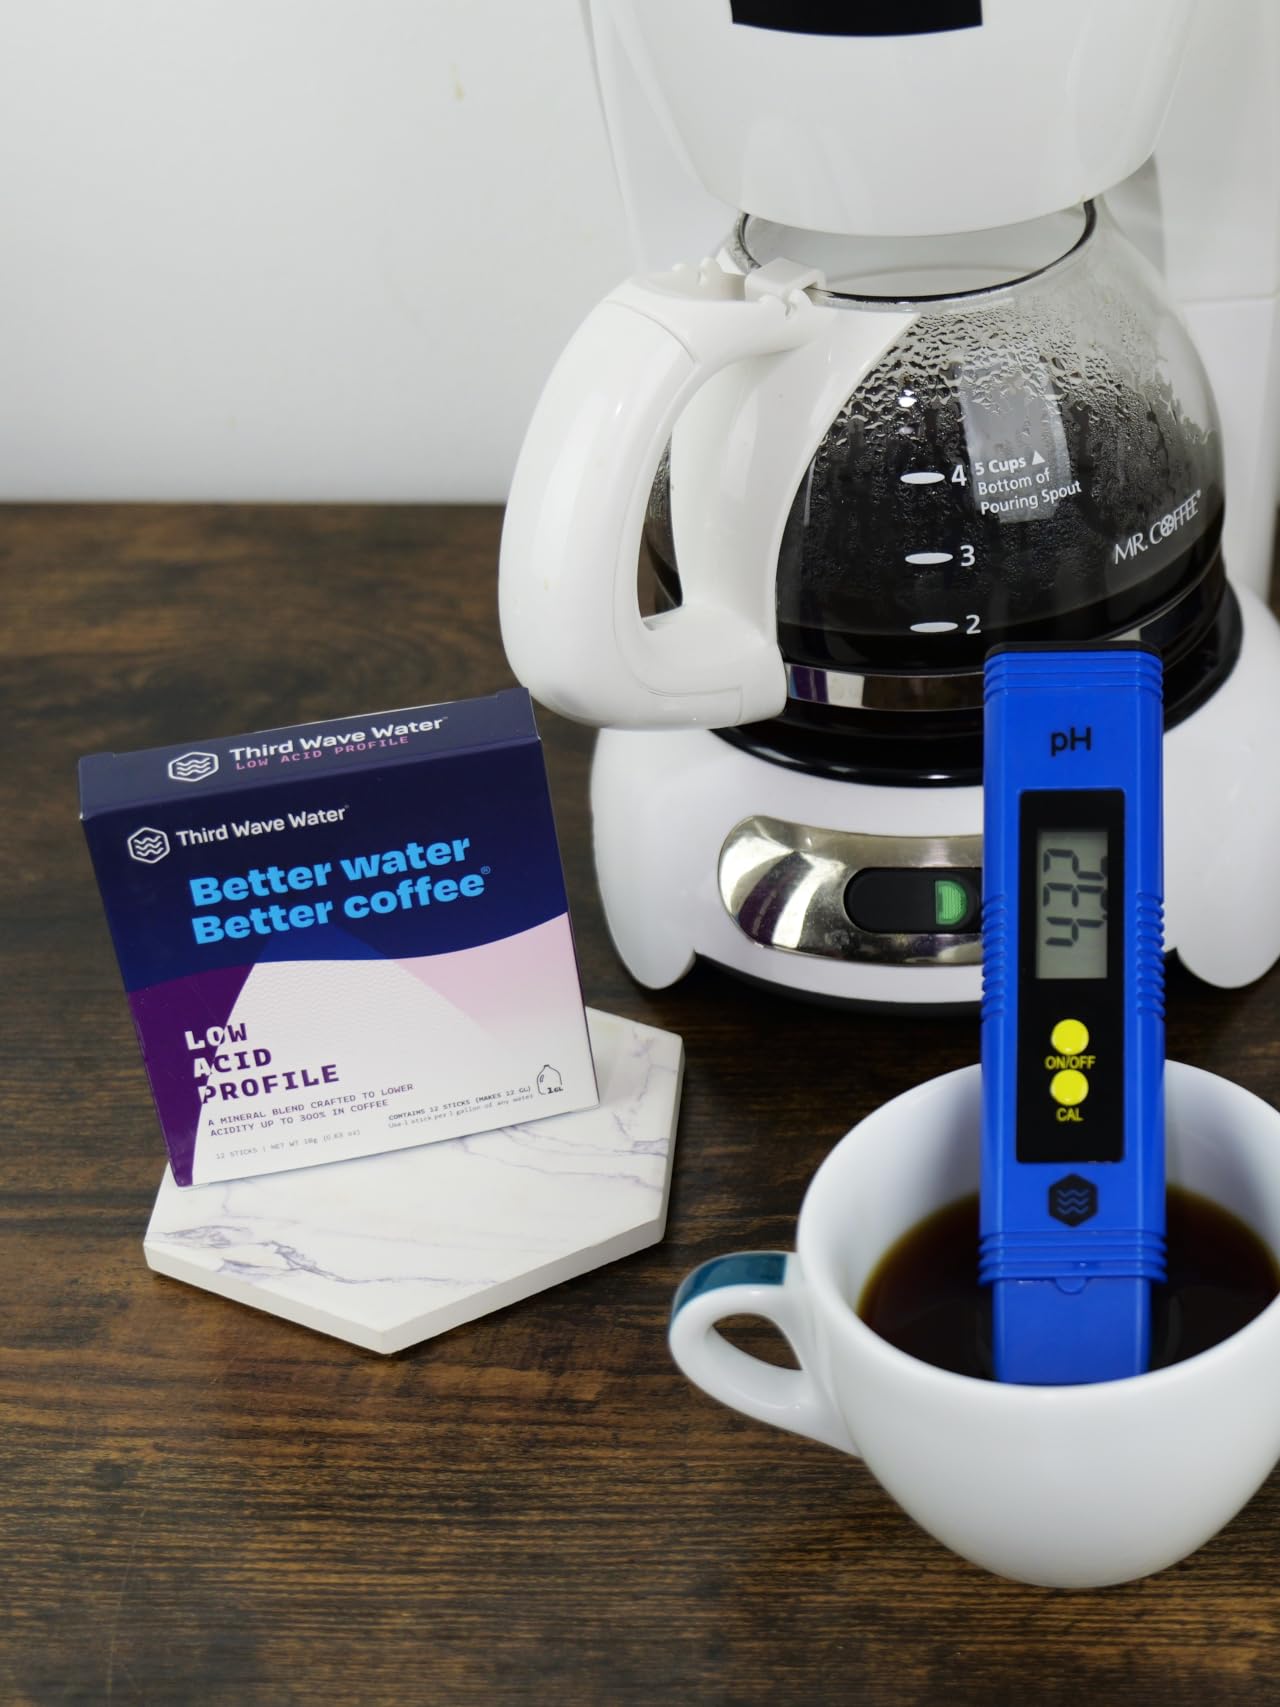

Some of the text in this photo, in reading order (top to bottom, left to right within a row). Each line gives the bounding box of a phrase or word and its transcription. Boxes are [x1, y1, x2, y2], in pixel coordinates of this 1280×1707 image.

[951, 464, 967, 486] 4
[975, 456, 1027, 477] 5 Cups
[978, 468, 1051, 495] Bottom of
[981, 481, 1082, 516] Pouring Spout
[960, 545, 976, 566] 3
[1115, 532, 1148, 565] MR.
[965, 615, 981, 635] 2
[229, 739, 293, 761] Third
[300, 731, 366, 750] Wave
[236, 736, 408, 770] LOW ACID PROFILE
[1050, 726, 1092, 756] pH
[176, 824, 229, 846] Third
[231, 818, 285, 838] Wave
[189, 838, 470, 907] Better water
[192, 901, 333, 944] Better
[184, 1022, 248, 1050] LOW
[193, 1048, 272, 1078] ACID
[1045, 1055, 1096, 1070] ON/OFF
[197, 1064, 339, 1104] PROFILE
[208, 1083, 414, 1127] A MINERAL BLEND CRAFTED TO LOWER
[210, 1099, 389, 1137] ACIDITY UP TO 300% IN COFFEE
[388, 1108, 426, 1121] CONTAINS
[442, 1099, 471, 1110] STICKS
[475, 1093, 502, 1104] (MAKES
[1056, 1107, 1083, 1121] CAL
